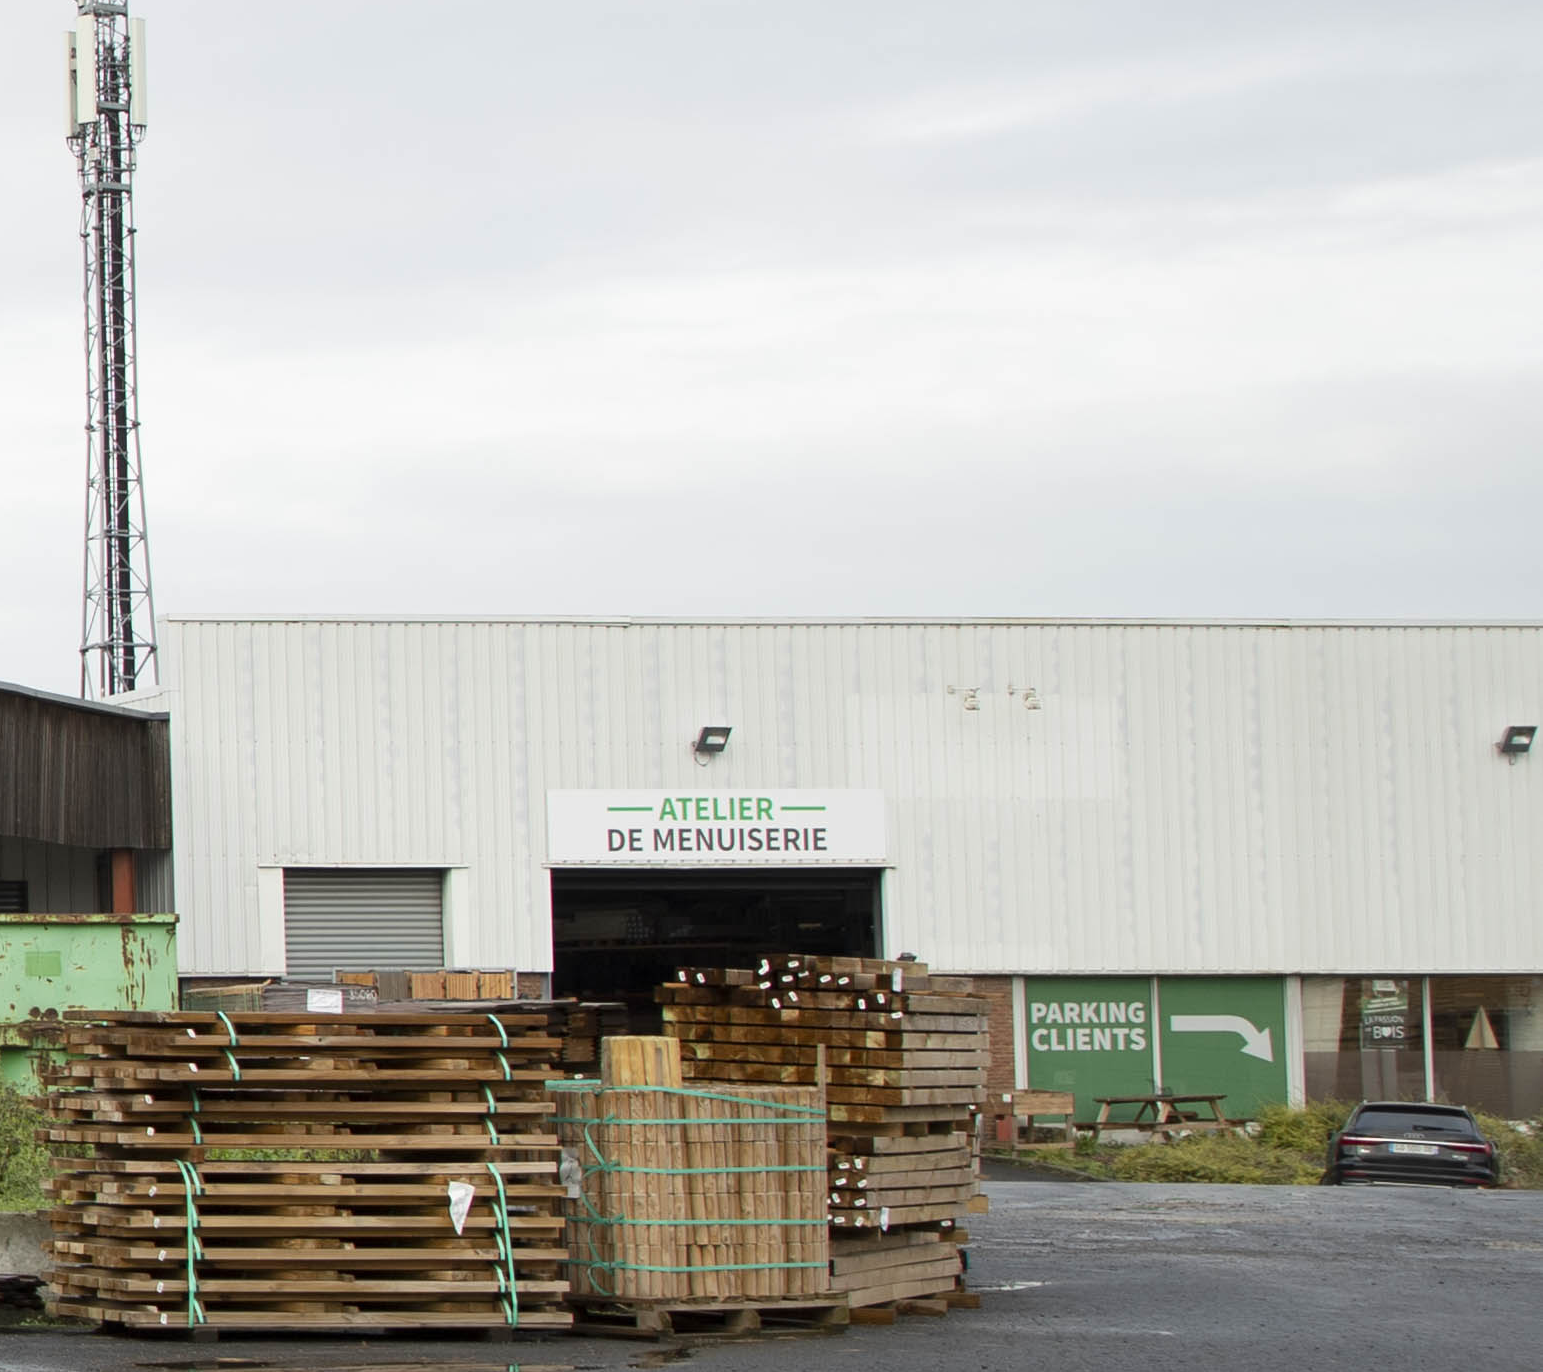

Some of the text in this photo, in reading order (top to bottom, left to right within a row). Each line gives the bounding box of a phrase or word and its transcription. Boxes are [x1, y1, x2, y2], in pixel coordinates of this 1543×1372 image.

[659, 797, 774, 821] ATELIER
[607, 827, 828, 852] DE MENUISERIE
[1030, 1001, 1145, 1025] PARKING
[1031, 1028, 1147, 1052] CLIENTS
